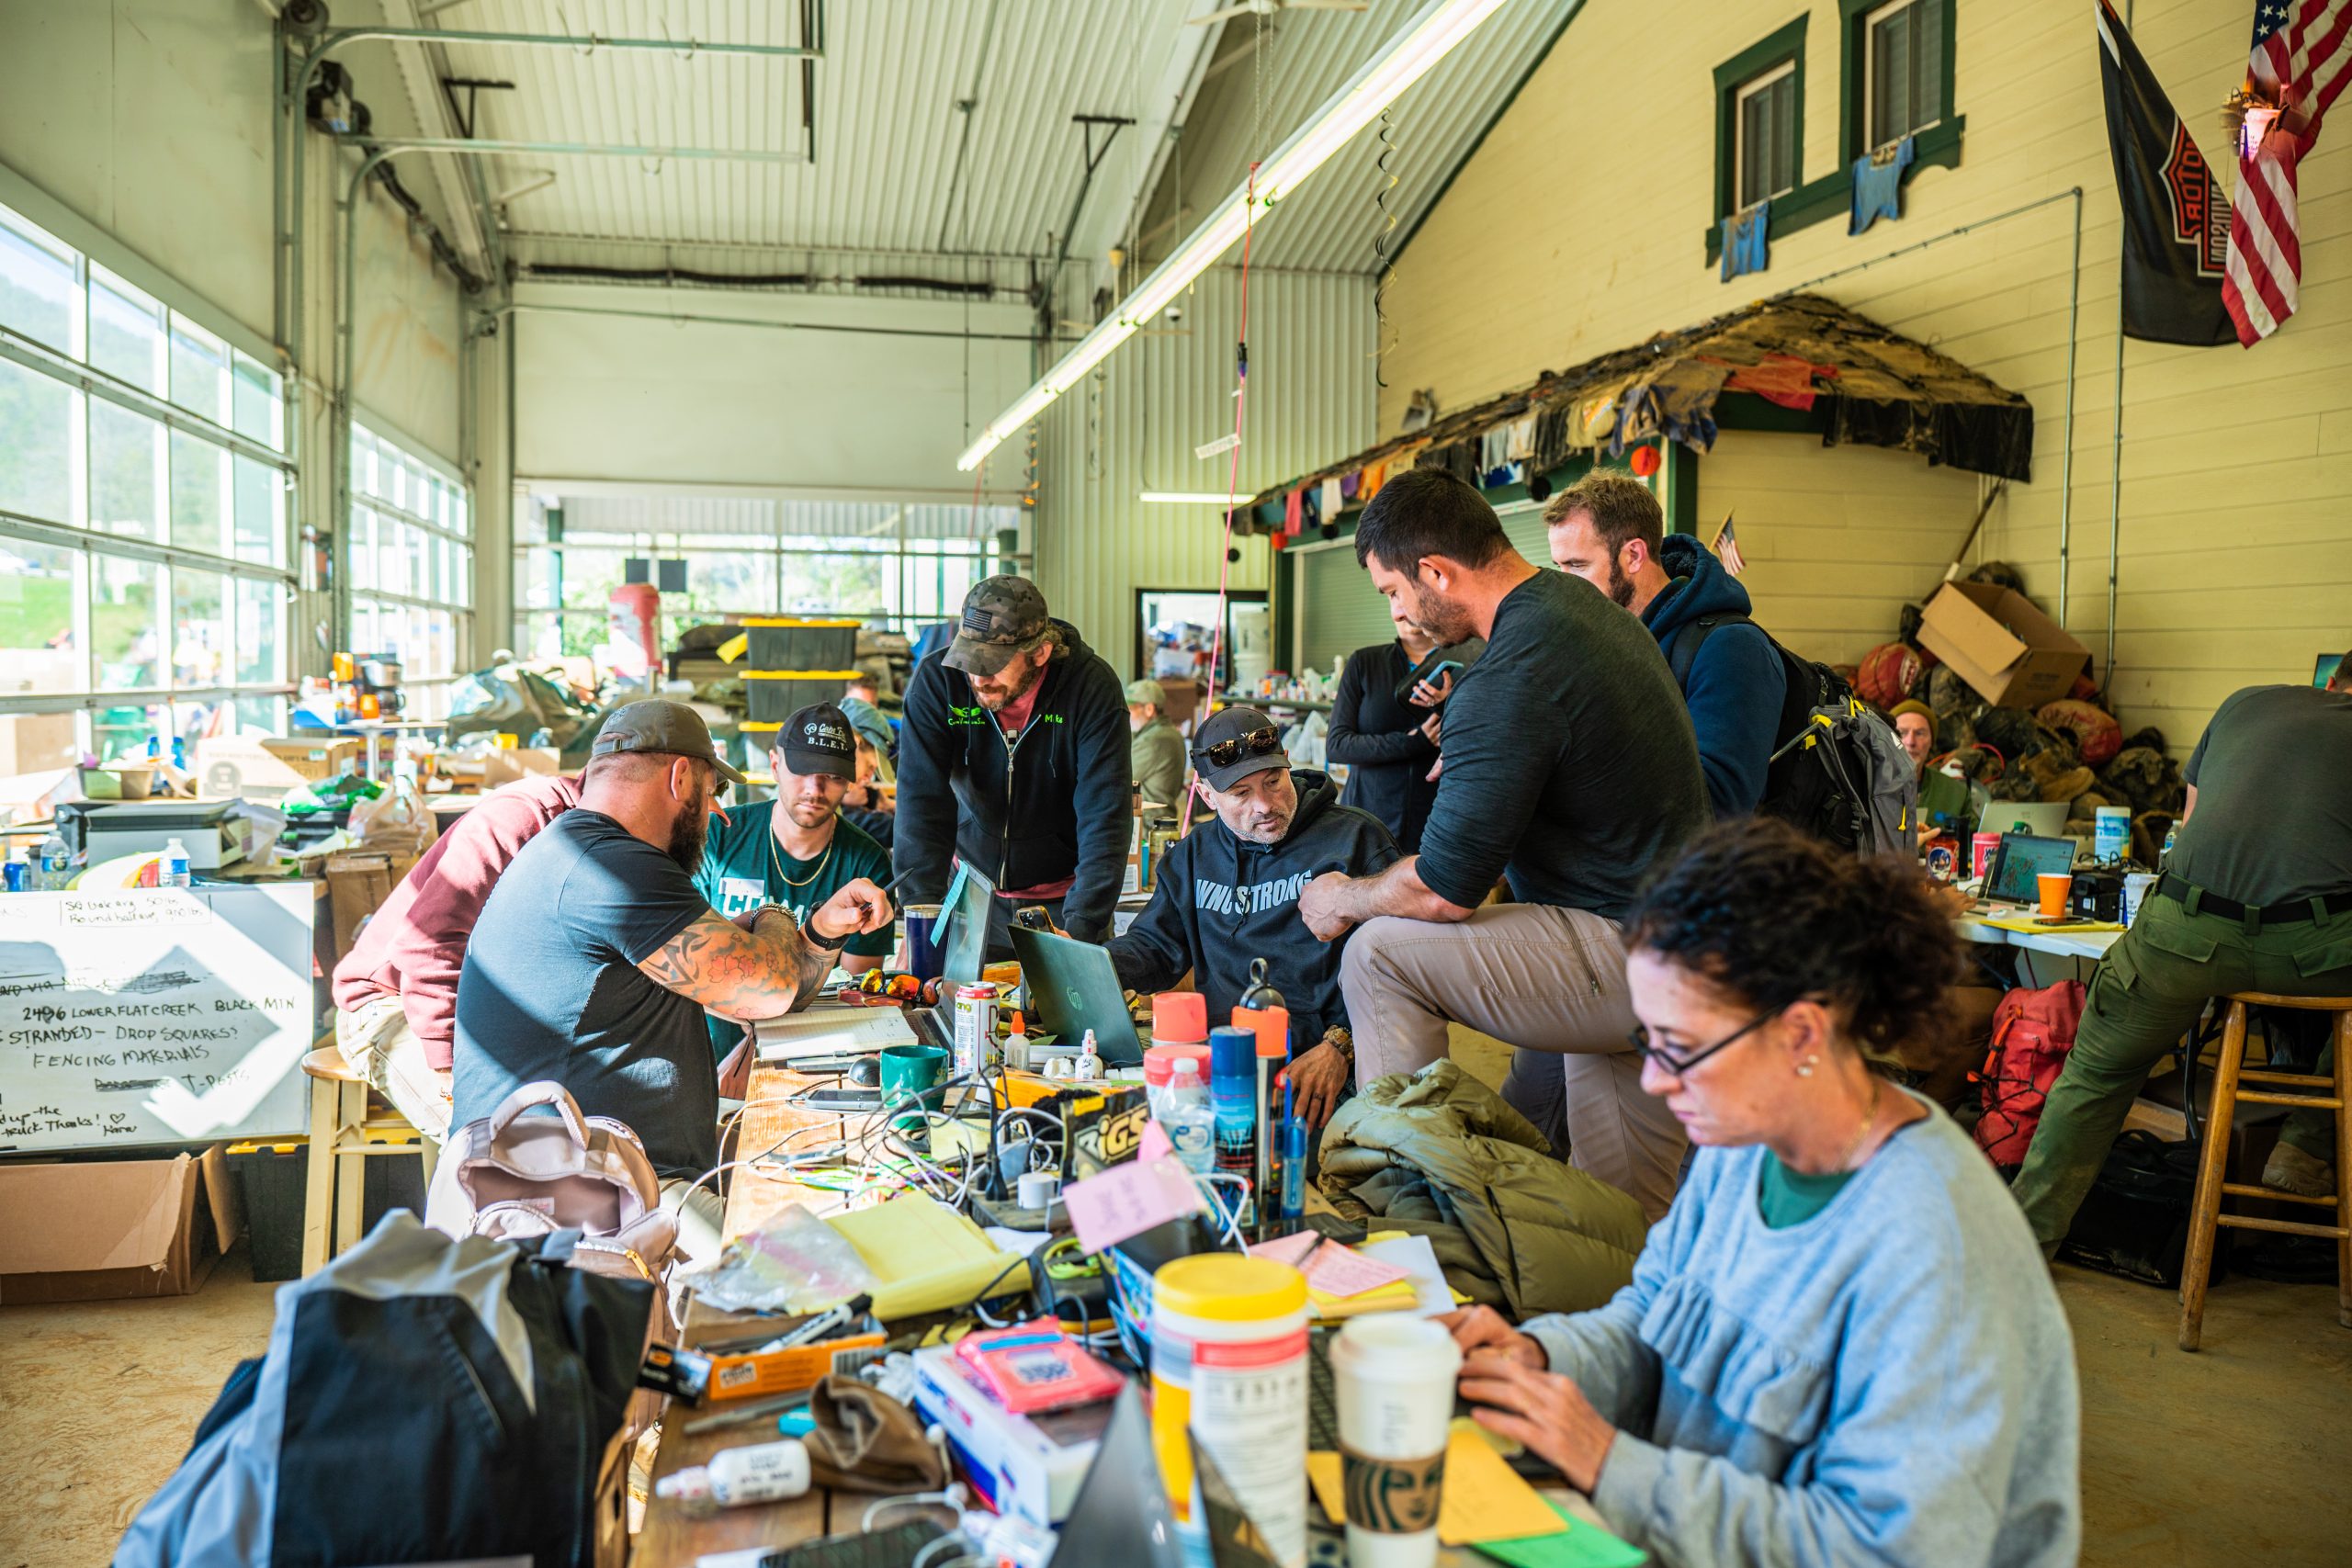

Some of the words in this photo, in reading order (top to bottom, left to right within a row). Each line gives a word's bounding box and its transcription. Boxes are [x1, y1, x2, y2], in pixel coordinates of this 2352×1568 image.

[1234, 869, 1313, 916] STRONG
[72, 1006, 117, 1018] LOWER
[118, 1005, 150, 1017] FLAT
[151, 1003, 203, 1017] CREEK
[215, 999, 260, 1012] BLACK
[116, 1025, 156, 1041] DROP
[33, 1053, 116, 1069] FENCING
